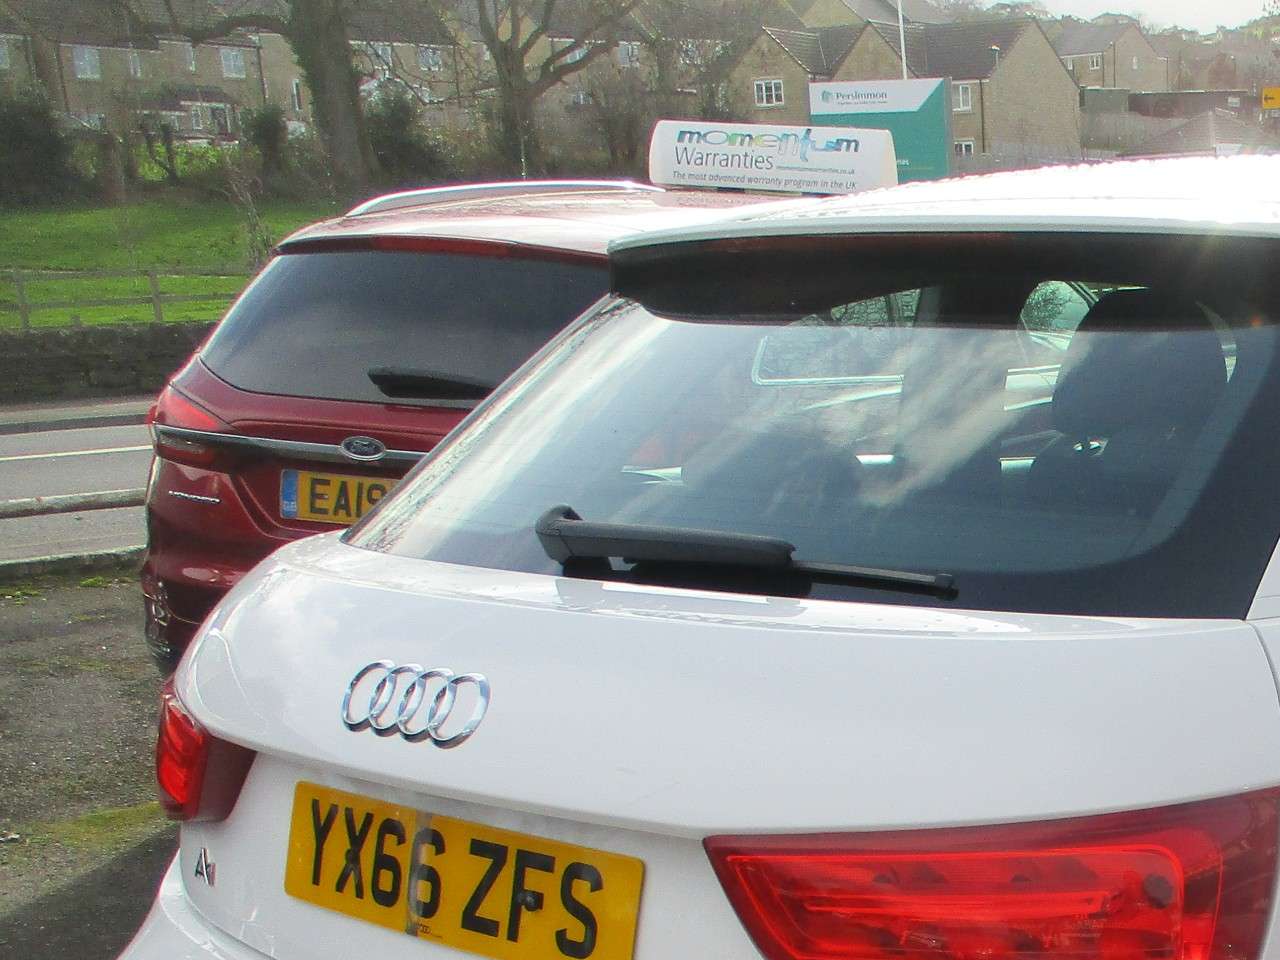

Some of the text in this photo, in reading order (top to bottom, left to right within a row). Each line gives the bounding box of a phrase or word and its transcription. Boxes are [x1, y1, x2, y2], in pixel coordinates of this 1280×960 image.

[675, 146, 774, 170] Warranties
[673, 171, 686, 179] The
[688, 173, 707, 181] most
[708, 174, 746, 184] advanced
[747, 176, 782, 188] warranty
[783, 178, 818, 189] program
[820, 180, 829, 188] in
[830, 180, 844, 188] the
[311, 798, 604, 960] YX66 ZFS
